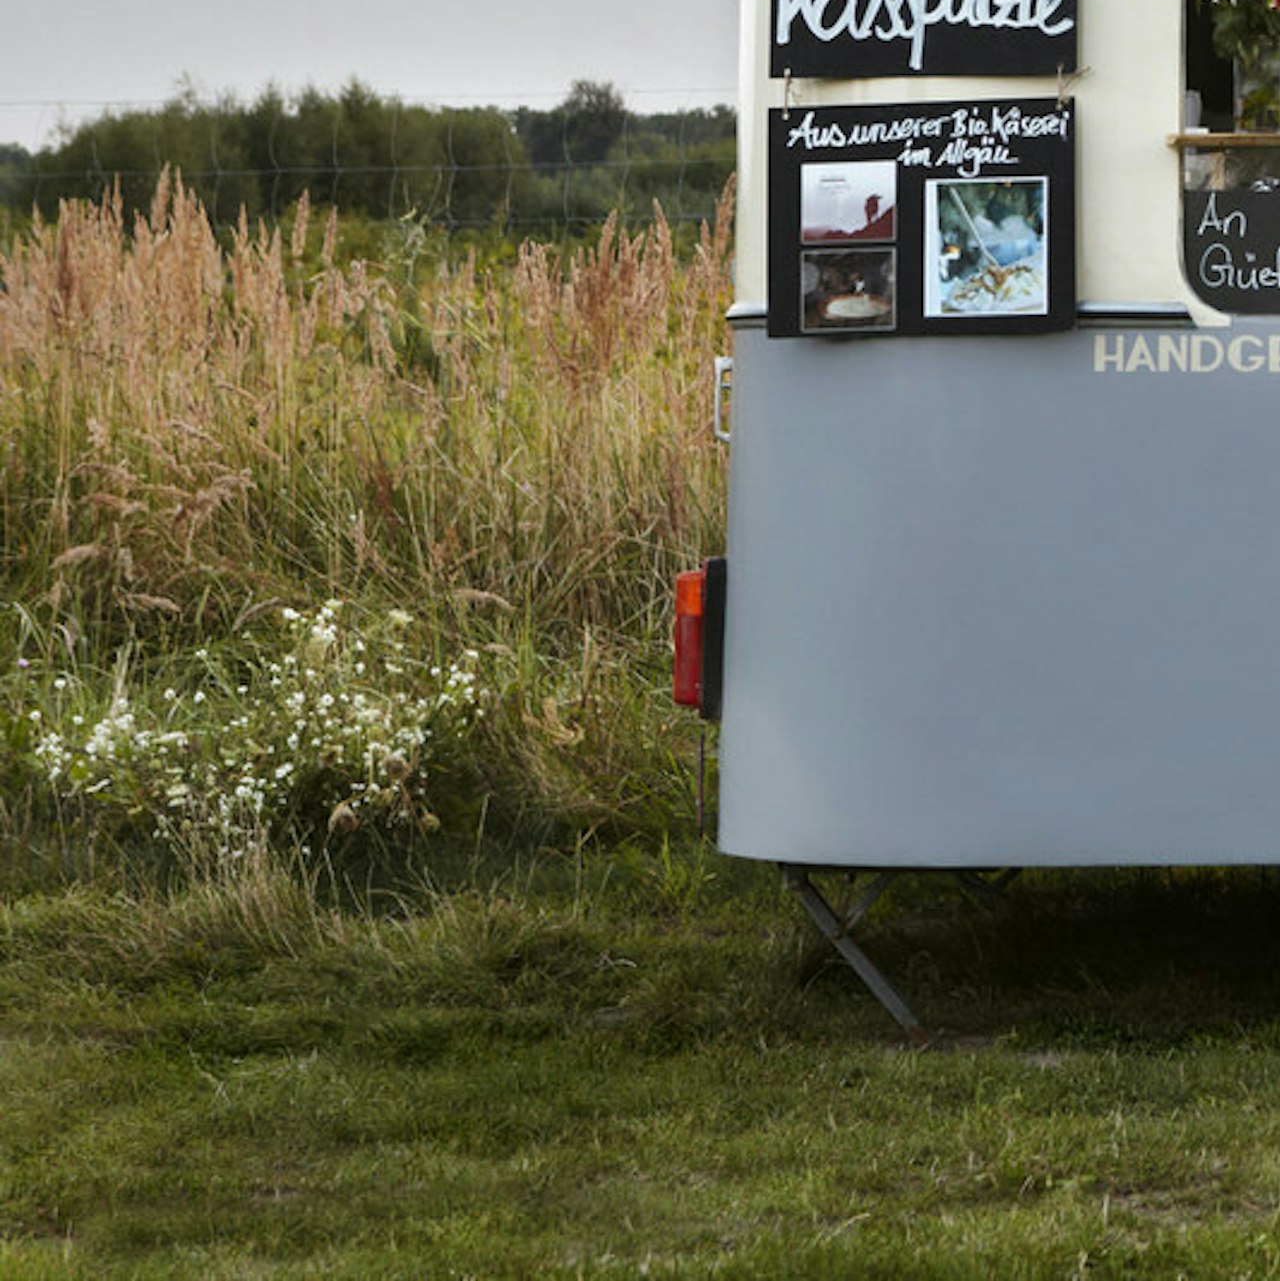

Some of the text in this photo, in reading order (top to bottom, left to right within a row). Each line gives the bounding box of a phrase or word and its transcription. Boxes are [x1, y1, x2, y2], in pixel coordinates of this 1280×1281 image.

[786, 110, 847, 150] Aus
[847, 116, 950, 146] unserer
[896, 136, 1019, 178] im Allgäu
[1197, 192, 1248, 238] An
